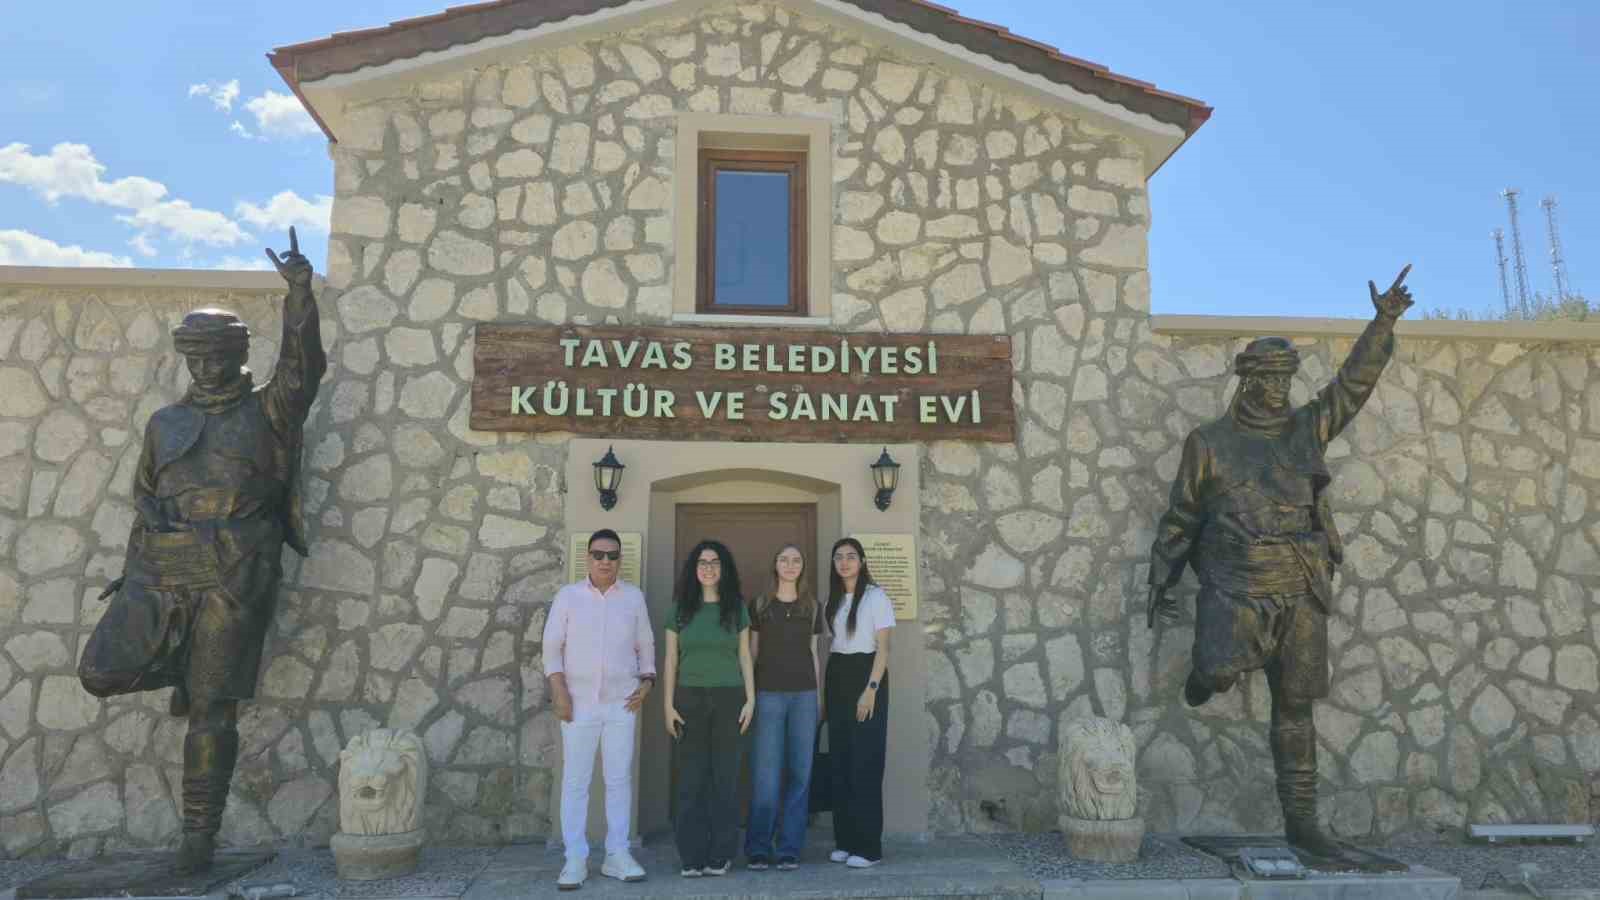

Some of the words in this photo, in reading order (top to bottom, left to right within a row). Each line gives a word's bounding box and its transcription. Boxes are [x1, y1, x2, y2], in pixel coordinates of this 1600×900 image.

[560, 339, 693, 369] TAVAS
[715, 339, 938, 375] BELEDİYESİ
[511, 381, 676, 418] KÜLTÜR
[696, 390, 745, 420] VE
[768, 392, 899, 422] SANAT
[920, 389, 981, 423] EVİ
